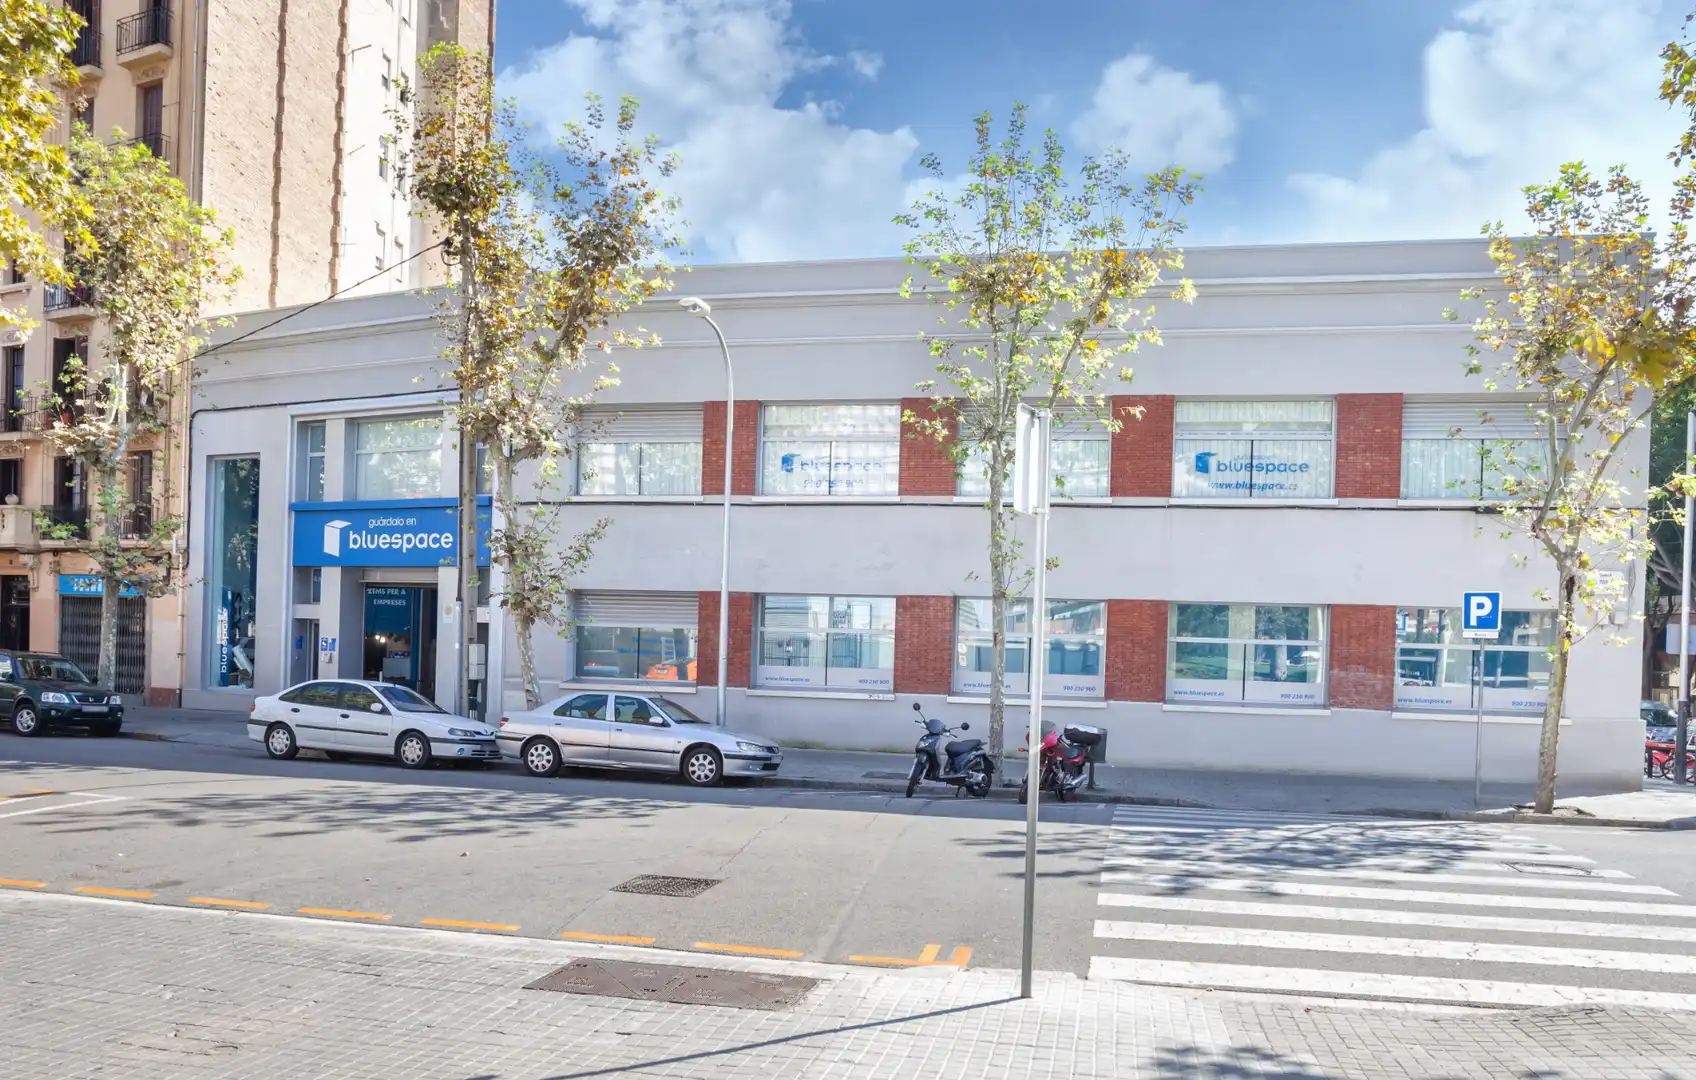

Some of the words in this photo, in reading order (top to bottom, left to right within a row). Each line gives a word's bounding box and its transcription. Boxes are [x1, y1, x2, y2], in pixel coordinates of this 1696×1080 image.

[1216, 460, 1310, 475] bluespace
[405, 517, 417, 526] en
[349, 530, 454, 553] bluespace
[387, 588, 400, 596] PER
[1470, 596, 1493, 626] P
